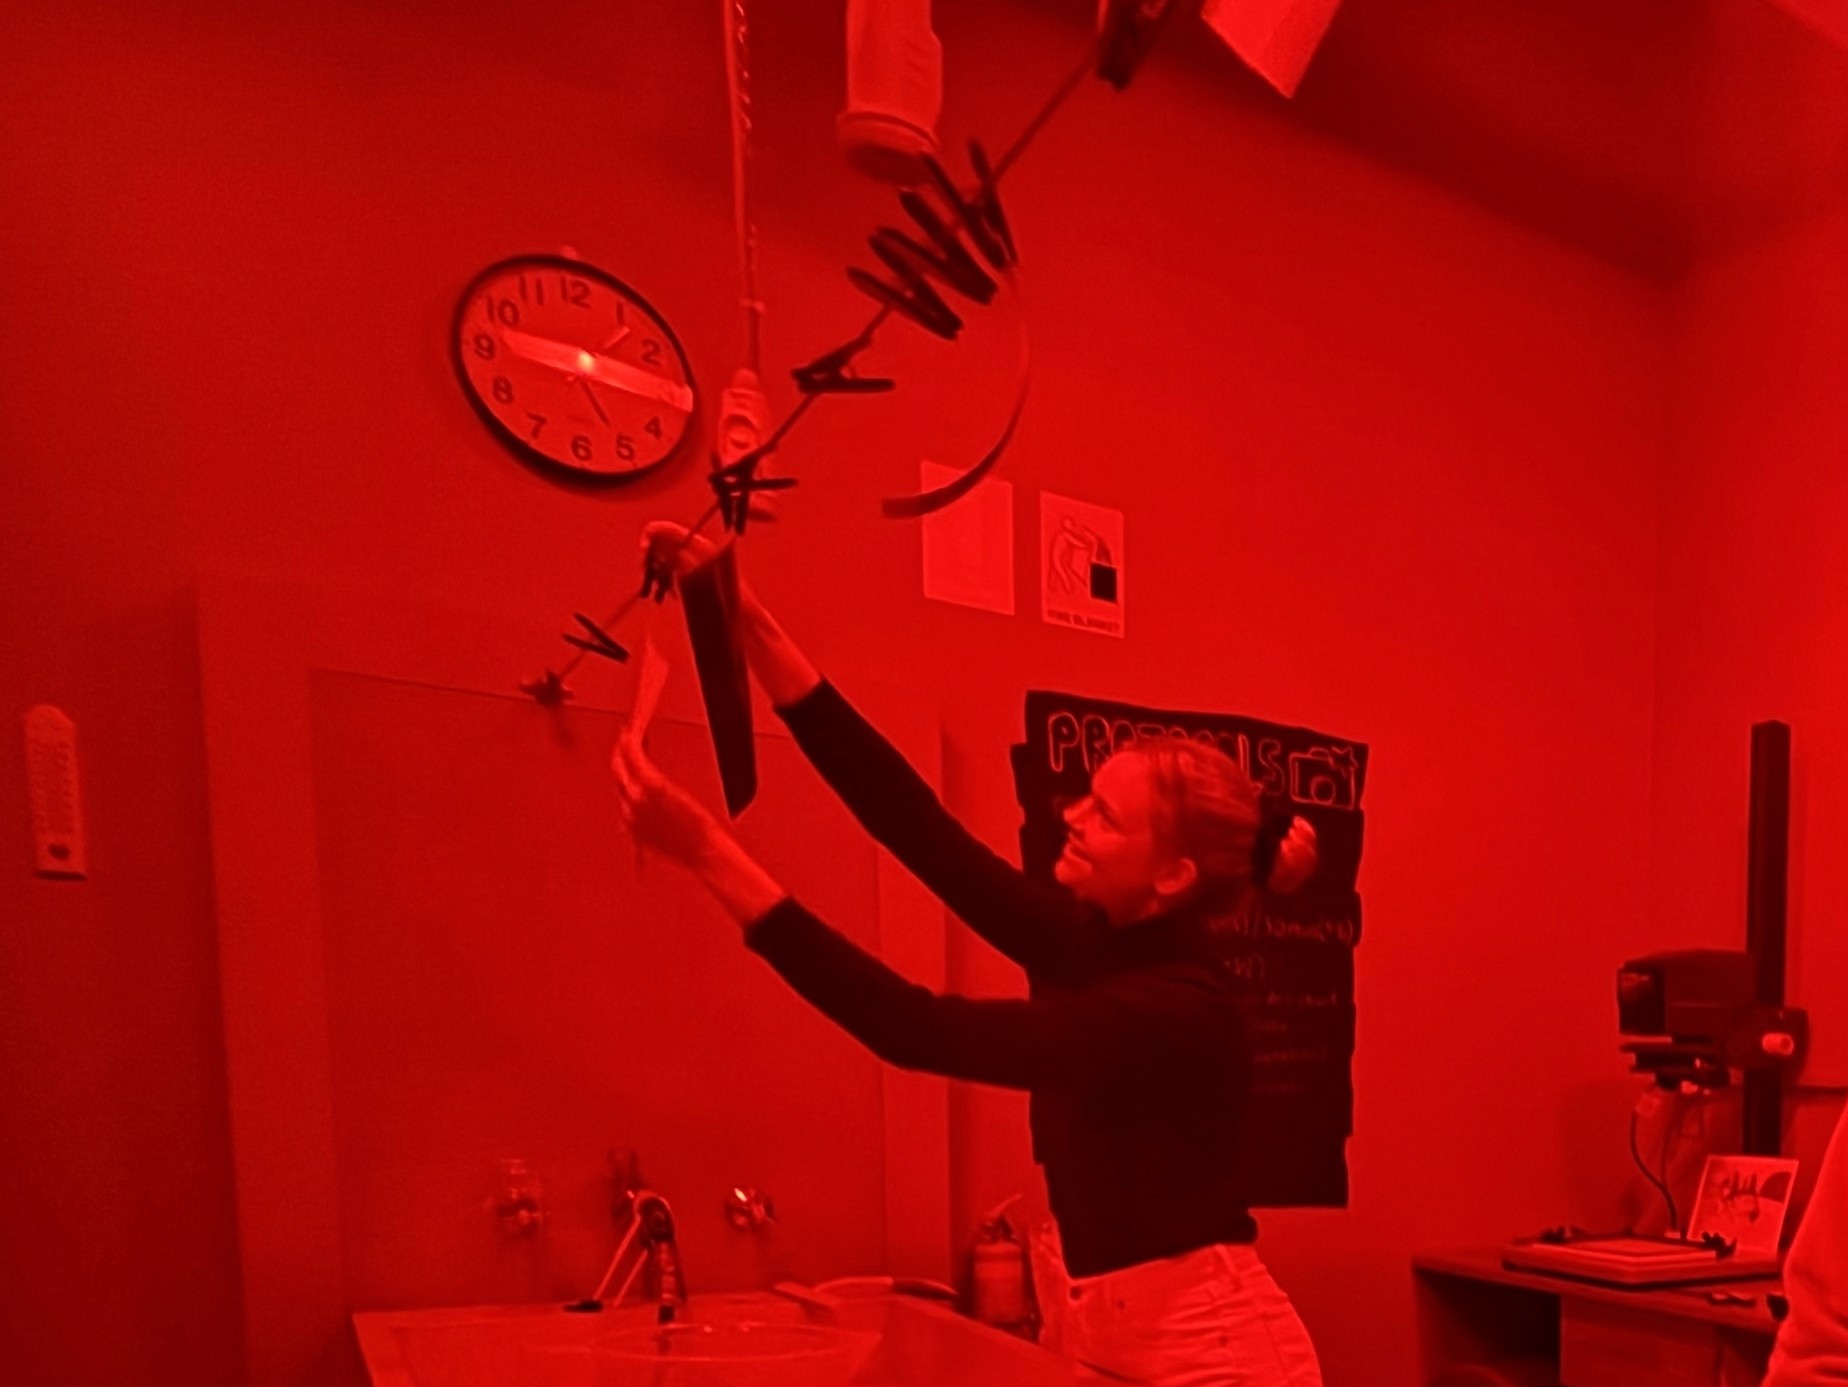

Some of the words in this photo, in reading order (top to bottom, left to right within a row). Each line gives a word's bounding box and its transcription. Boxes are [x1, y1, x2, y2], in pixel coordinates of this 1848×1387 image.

[519, 274, 544, 305] 11
[560, 277, 591, 309] 12
[486, 294, 520, 326] 10
[616, 303, 625, 325] 1
[474, 334, 495, 360] 9
[641, 339, 662, 365] 2
[492, 377, 514, 404] 8
[526, 412, 548, 439] 7
[644, 416, 663, 440] 4
[571, 435, 593, 461] 6
[615, 433, 635, 461] 5
